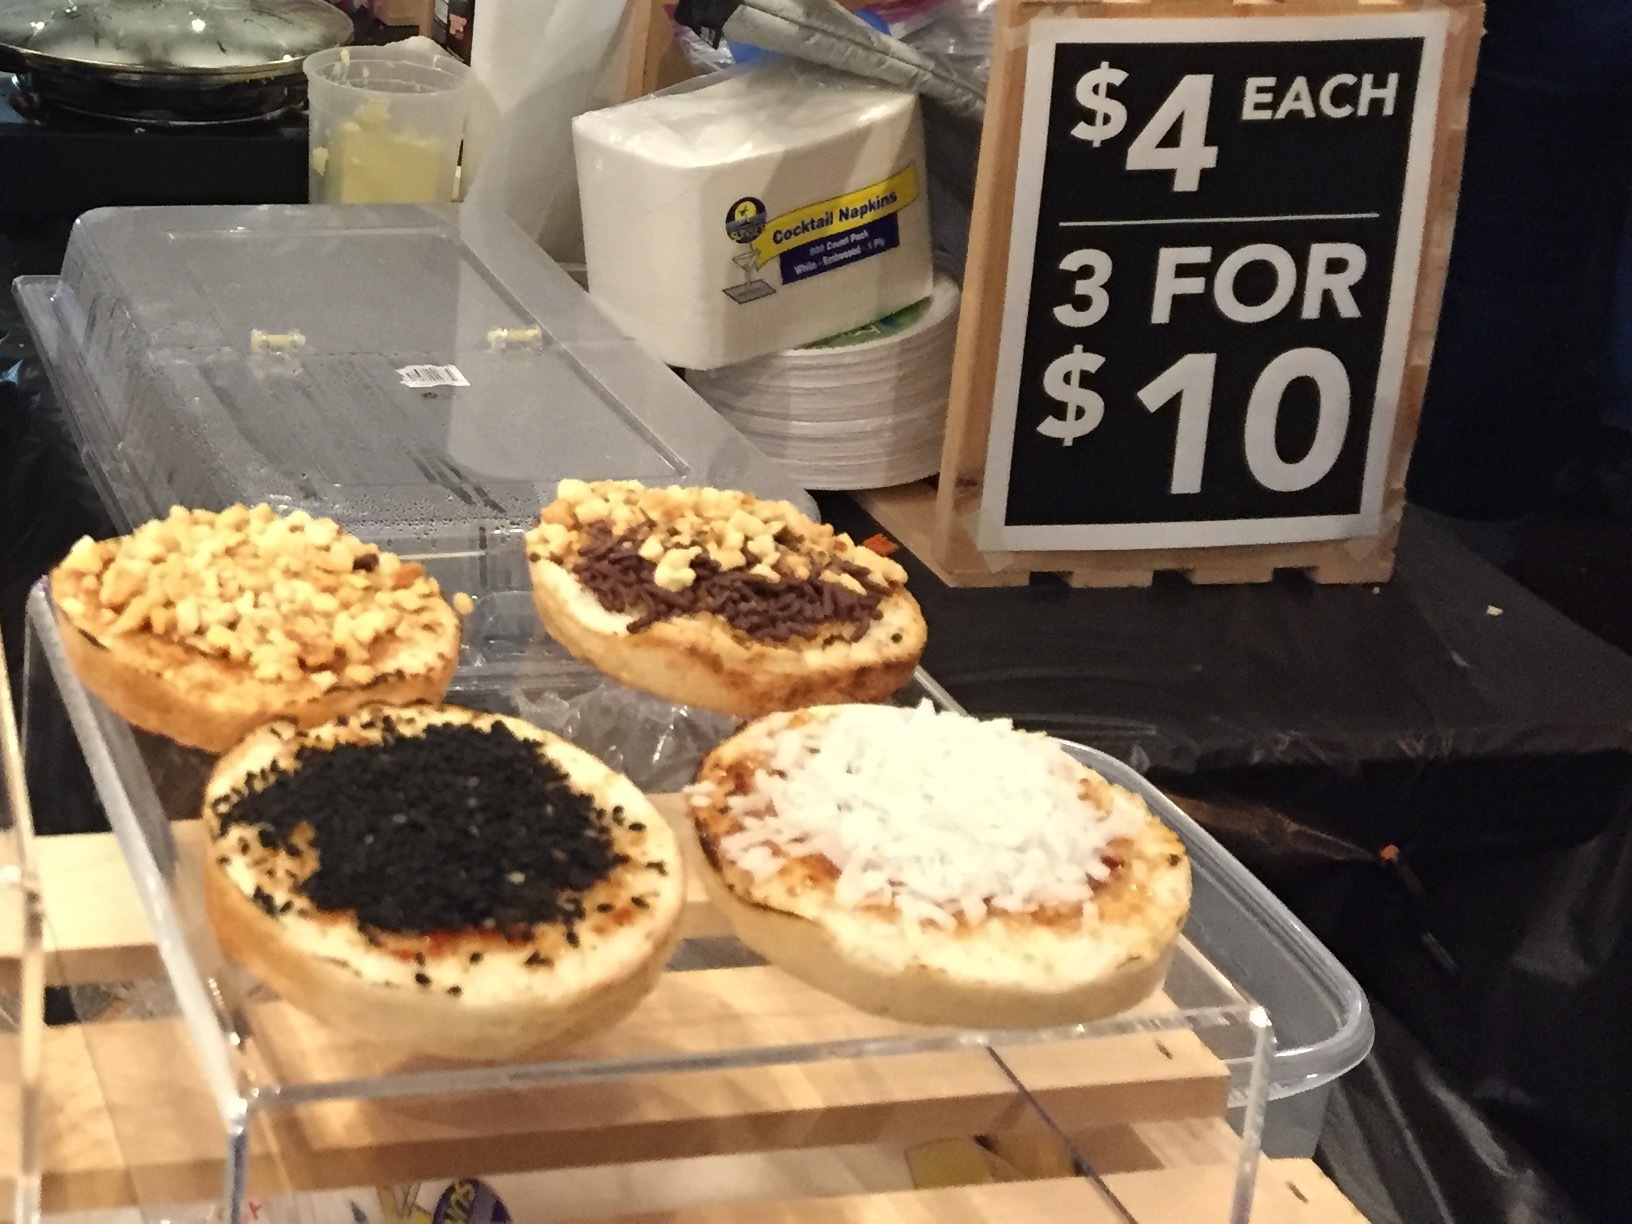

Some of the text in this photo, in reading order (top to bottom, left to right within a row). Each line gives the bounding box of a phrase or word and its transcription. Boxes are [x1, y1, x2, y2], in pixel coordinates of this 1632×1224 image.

[1069, 60, 1399, 193] $4 EACH
[772, 190, 898, 245] Cocktail Napkins
[1052, 242, 1368, 328] 3 FOR
